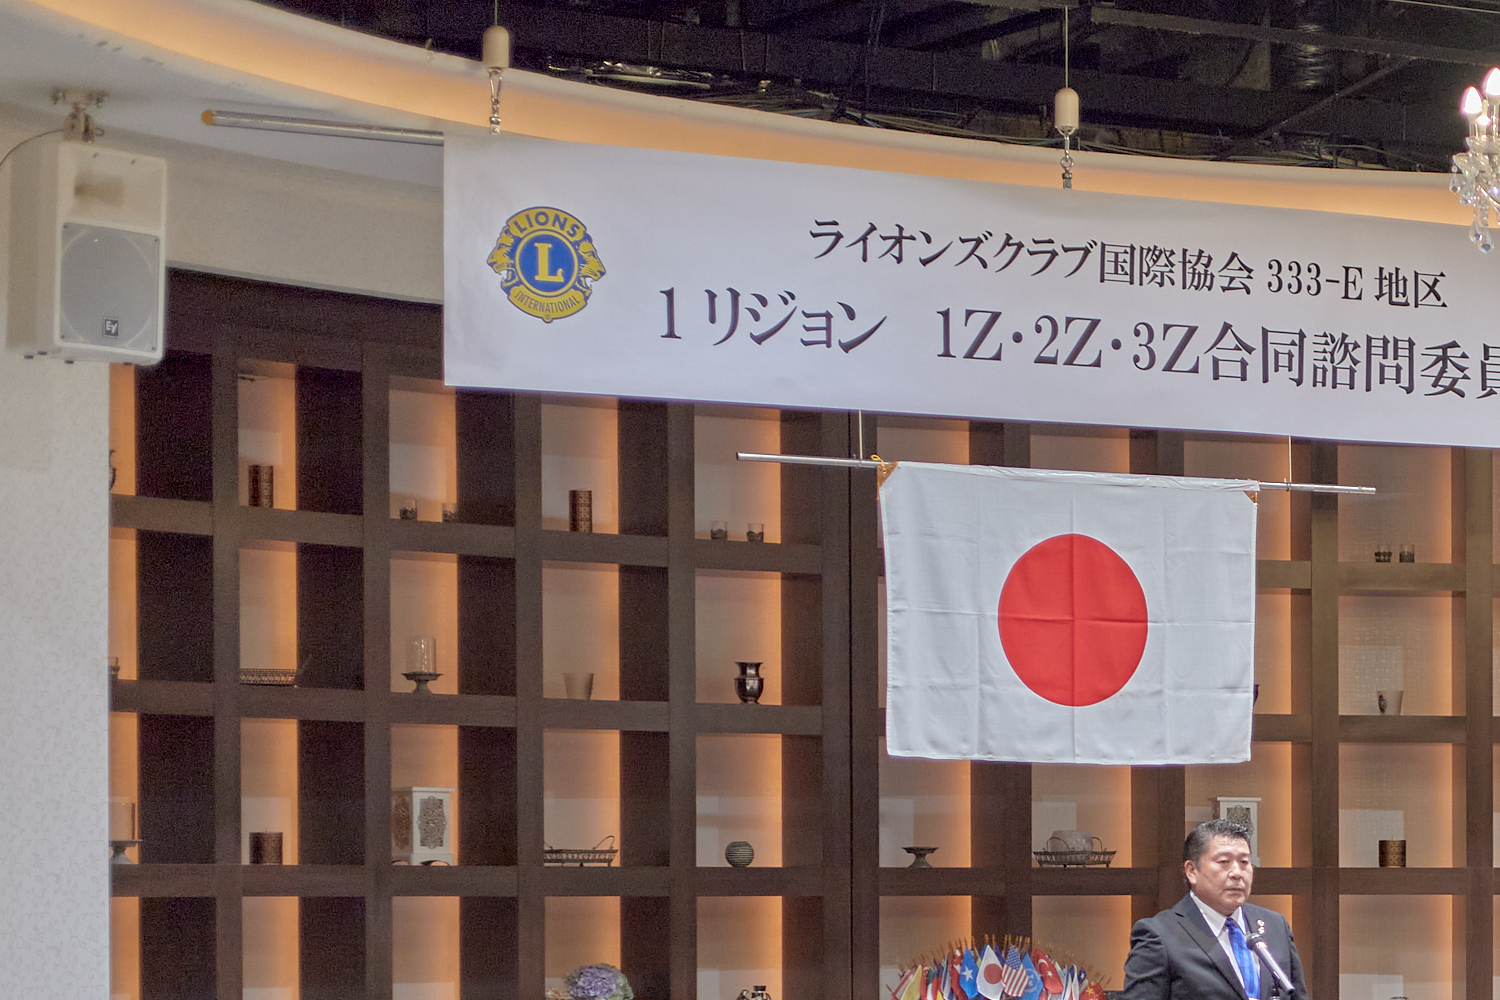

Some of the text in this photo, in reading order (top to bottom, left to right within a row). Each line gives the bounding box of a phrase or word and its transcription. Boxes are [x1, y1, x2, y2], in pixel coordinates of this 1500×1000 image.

[513, 210, 581, 238] LIONS
[534, 242, 564, 282] L
[514, 290, 581, 314] INTERNATIONAL
